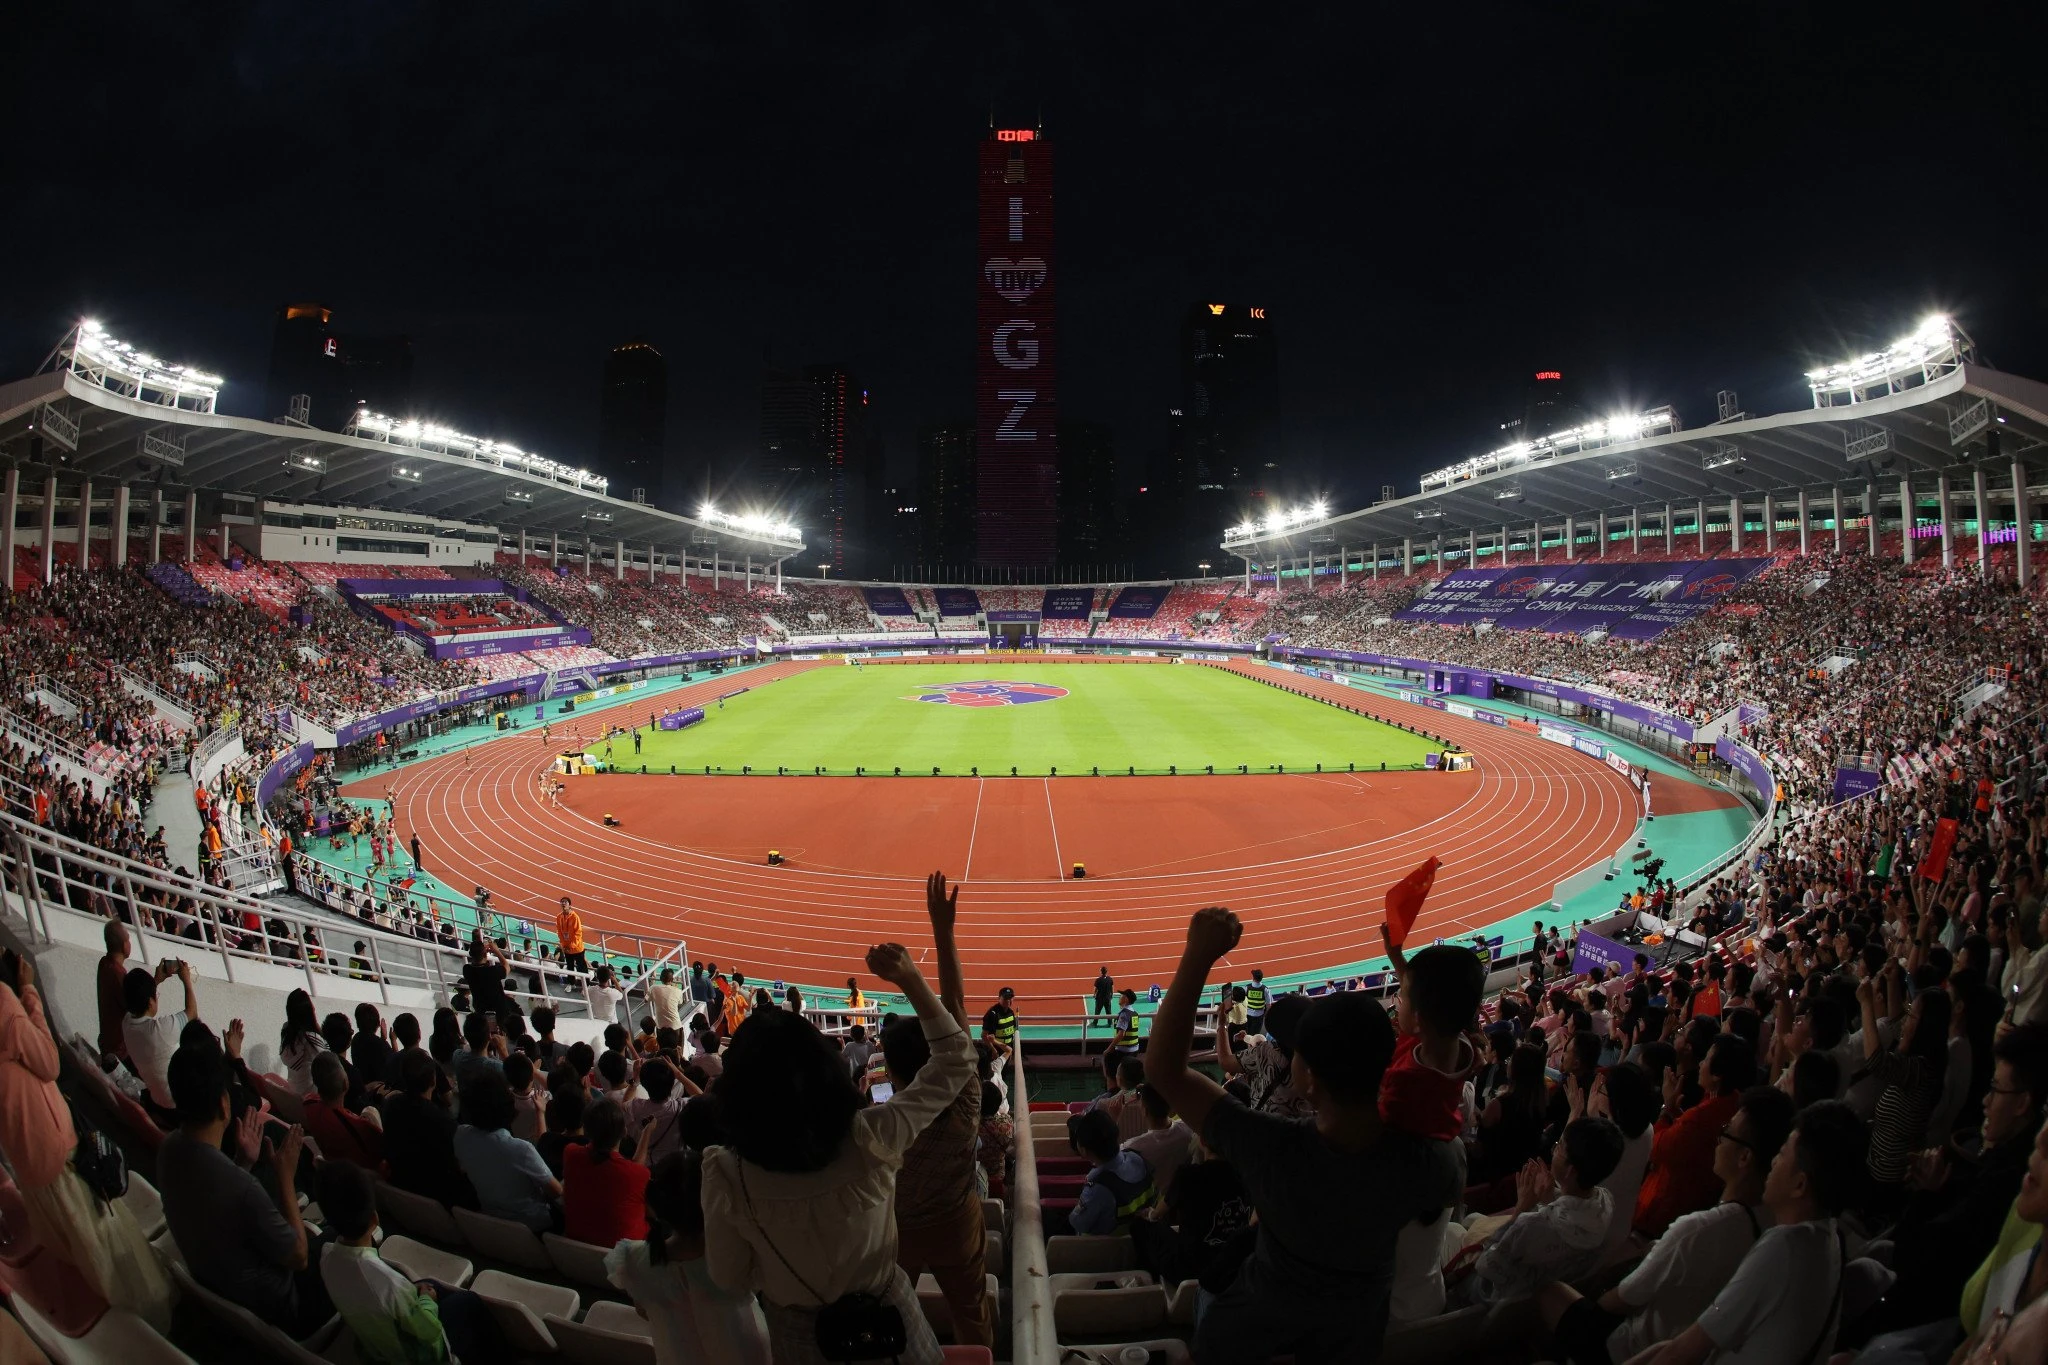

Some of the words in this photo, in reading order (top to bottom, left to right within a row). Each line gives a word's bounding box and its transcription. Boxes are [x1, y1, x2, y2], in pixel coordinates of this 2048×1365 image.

[998, 130, 1034, 142] 中信
[1536, 371, 1561, 380] vanke
[1443, 580, 1494, 589] 2025年
[1525, 600, 1578, 612] CHINA
[1578, 602, 1640, 613] GUANGZHOU
[1580, 740, 1601, 758] MONDO
[1580, 941, 1608, 957] 2025广州
[1153, 988, 1159, 997] 8
